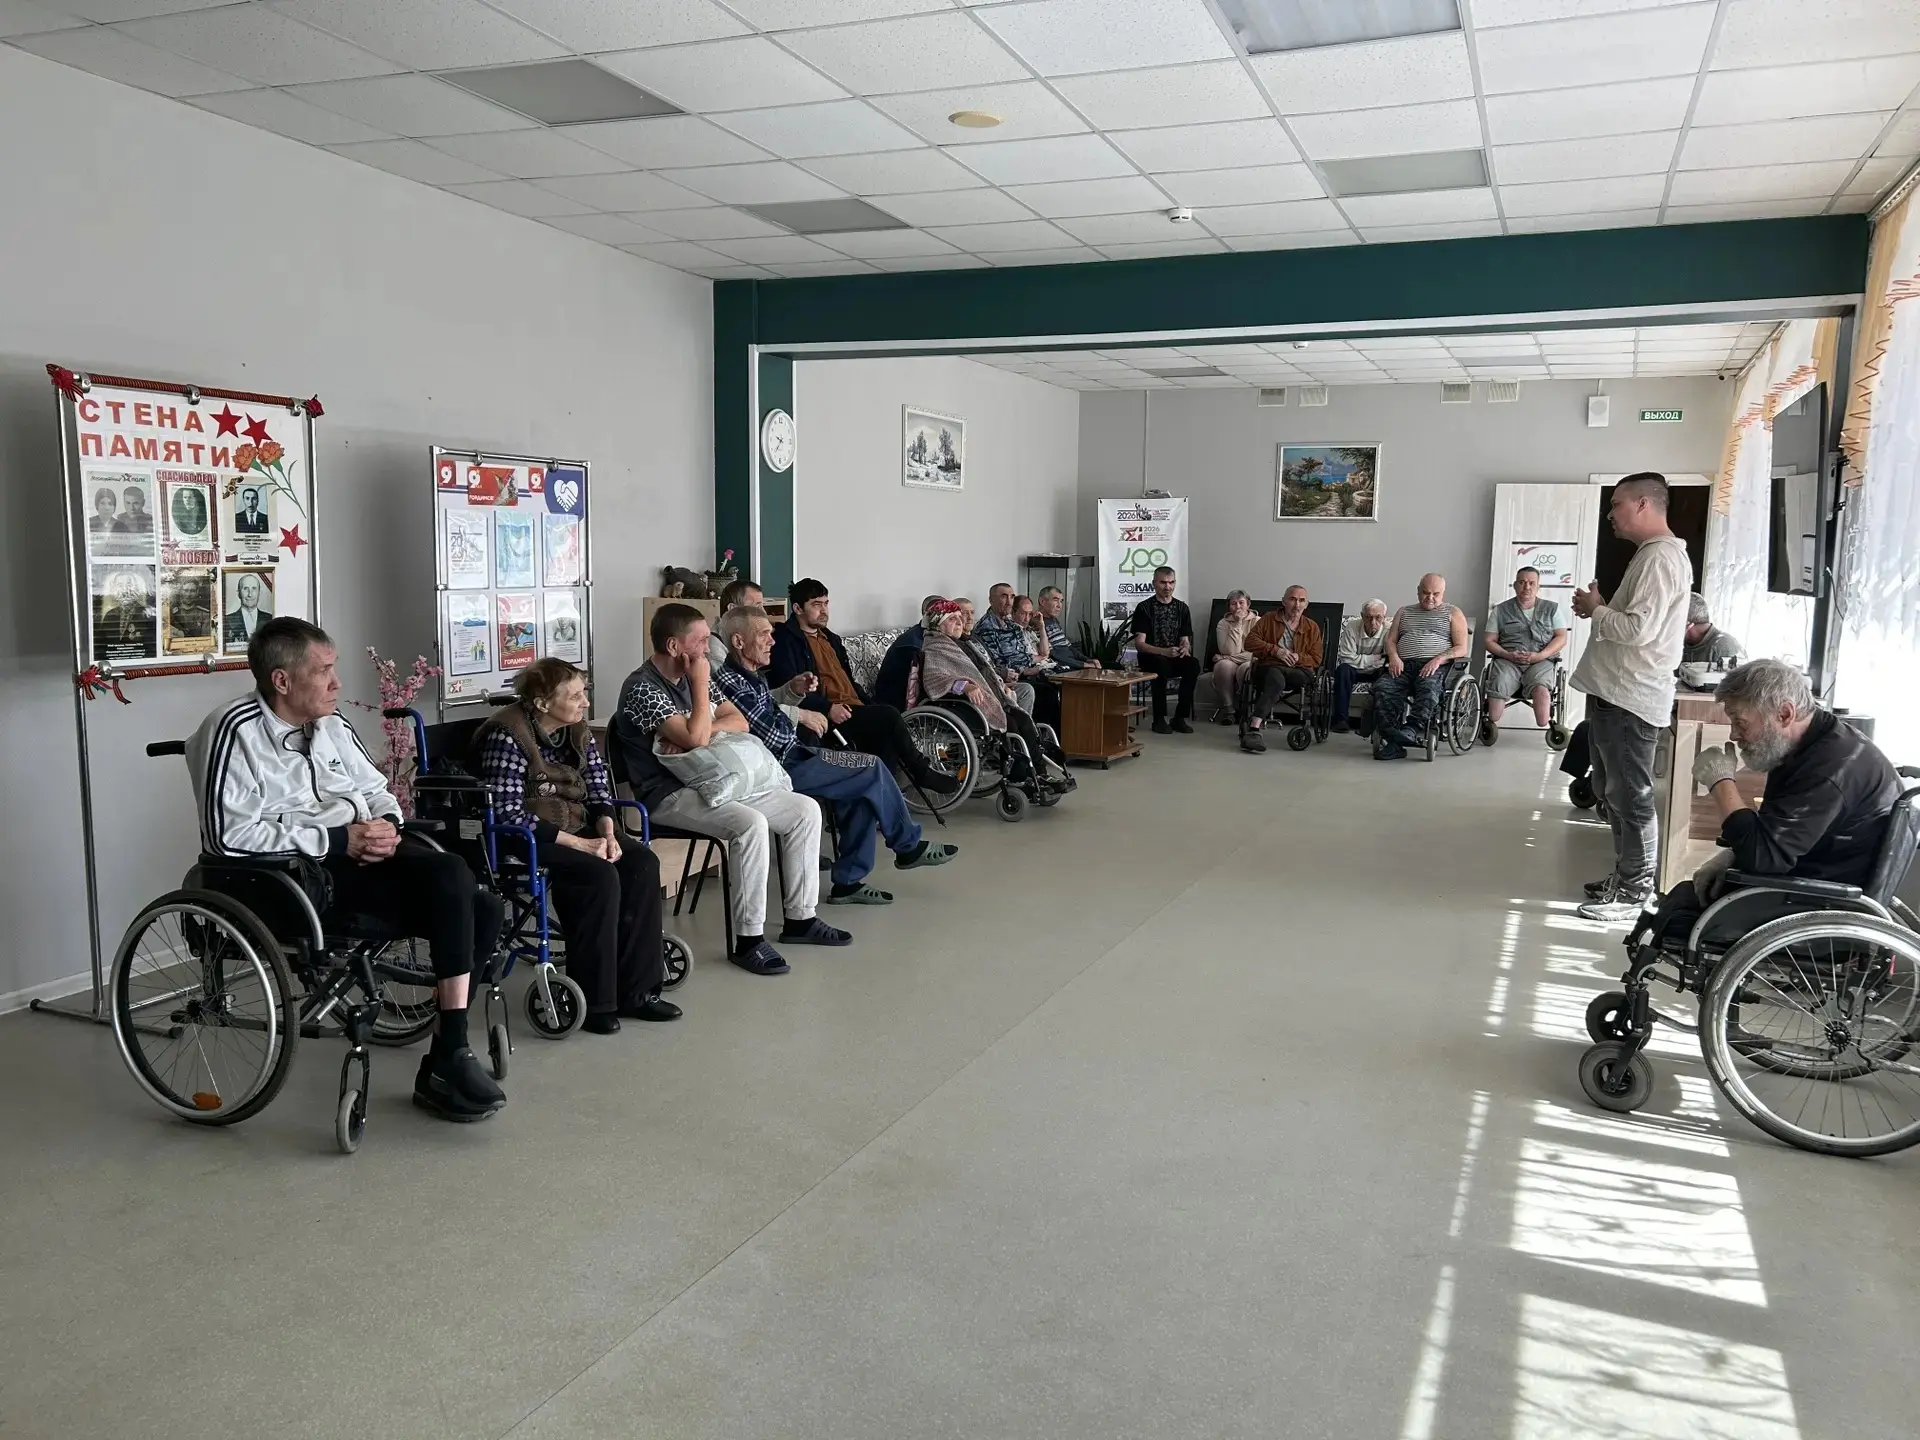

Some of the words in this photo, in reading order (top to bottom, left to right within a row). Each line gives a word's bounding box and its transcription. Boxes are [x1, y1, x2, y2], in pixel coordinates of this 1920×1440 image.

[78, 399, 205, 433] СТЕНА
[1644, 411, 1679, 420] ВЫХОД
[80, 433, 230, 468] ПАМЯТИ
[156, 470, 195, 484] СПАСИБО
[440, 466, 453, 484] 9
[468, 469, 481, 489] 9
[531, 472, 541, 490] 9
[1117, 512, 1136, 520] 2026
[179, 550, 220, 565] ПОБЕДУ
[1119, 547, 1168, 576] 400
[1532, 554, 1556, 567] 400
[821, 750, 877, 769] RUSSIA
